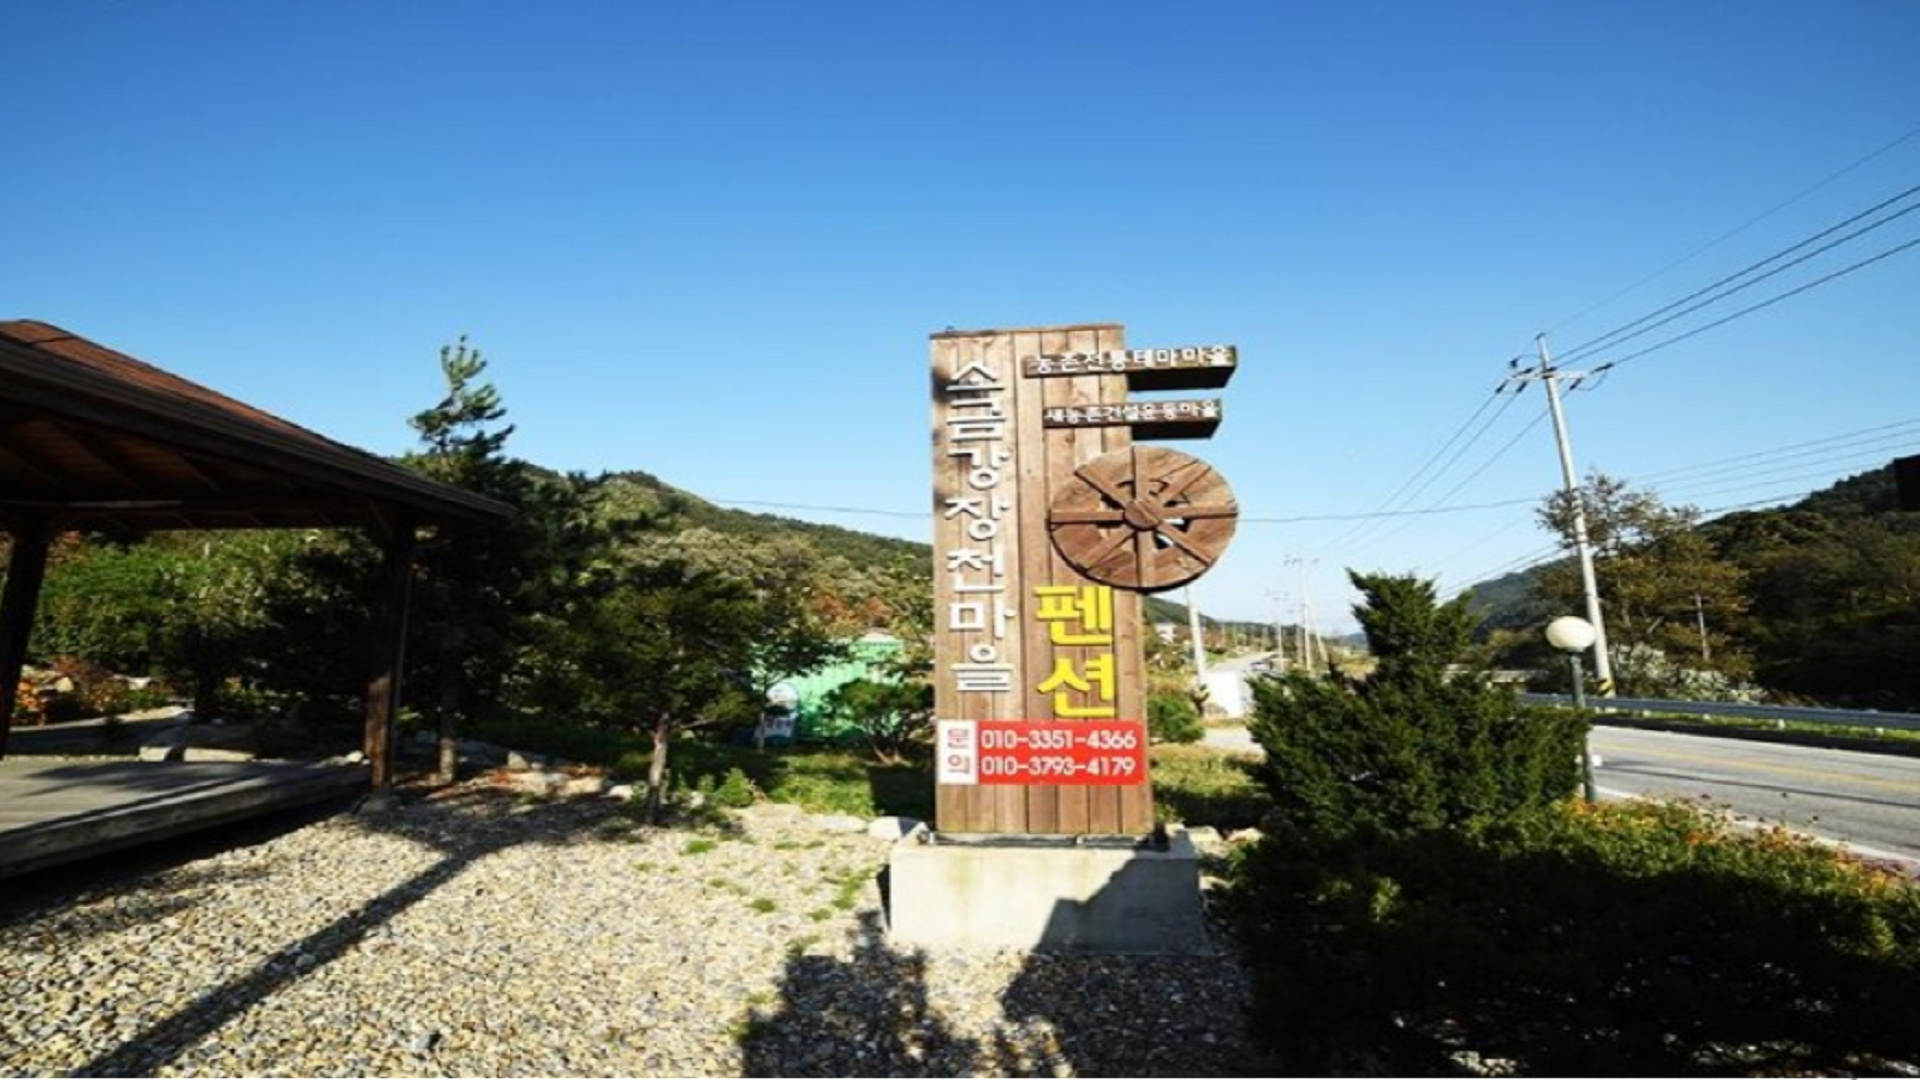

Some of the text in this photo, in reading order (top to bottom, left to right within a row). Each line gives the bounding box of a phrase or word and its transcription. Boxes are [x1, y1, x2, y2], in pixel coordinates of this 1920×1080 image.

[1033, 585, 1116, 718] 펜션
[947, 728, 971, 775] 문의
[980, 729, 1137, 749] 010-3351-4366
[980, 756, 1137, 776] 010-3793-4179
